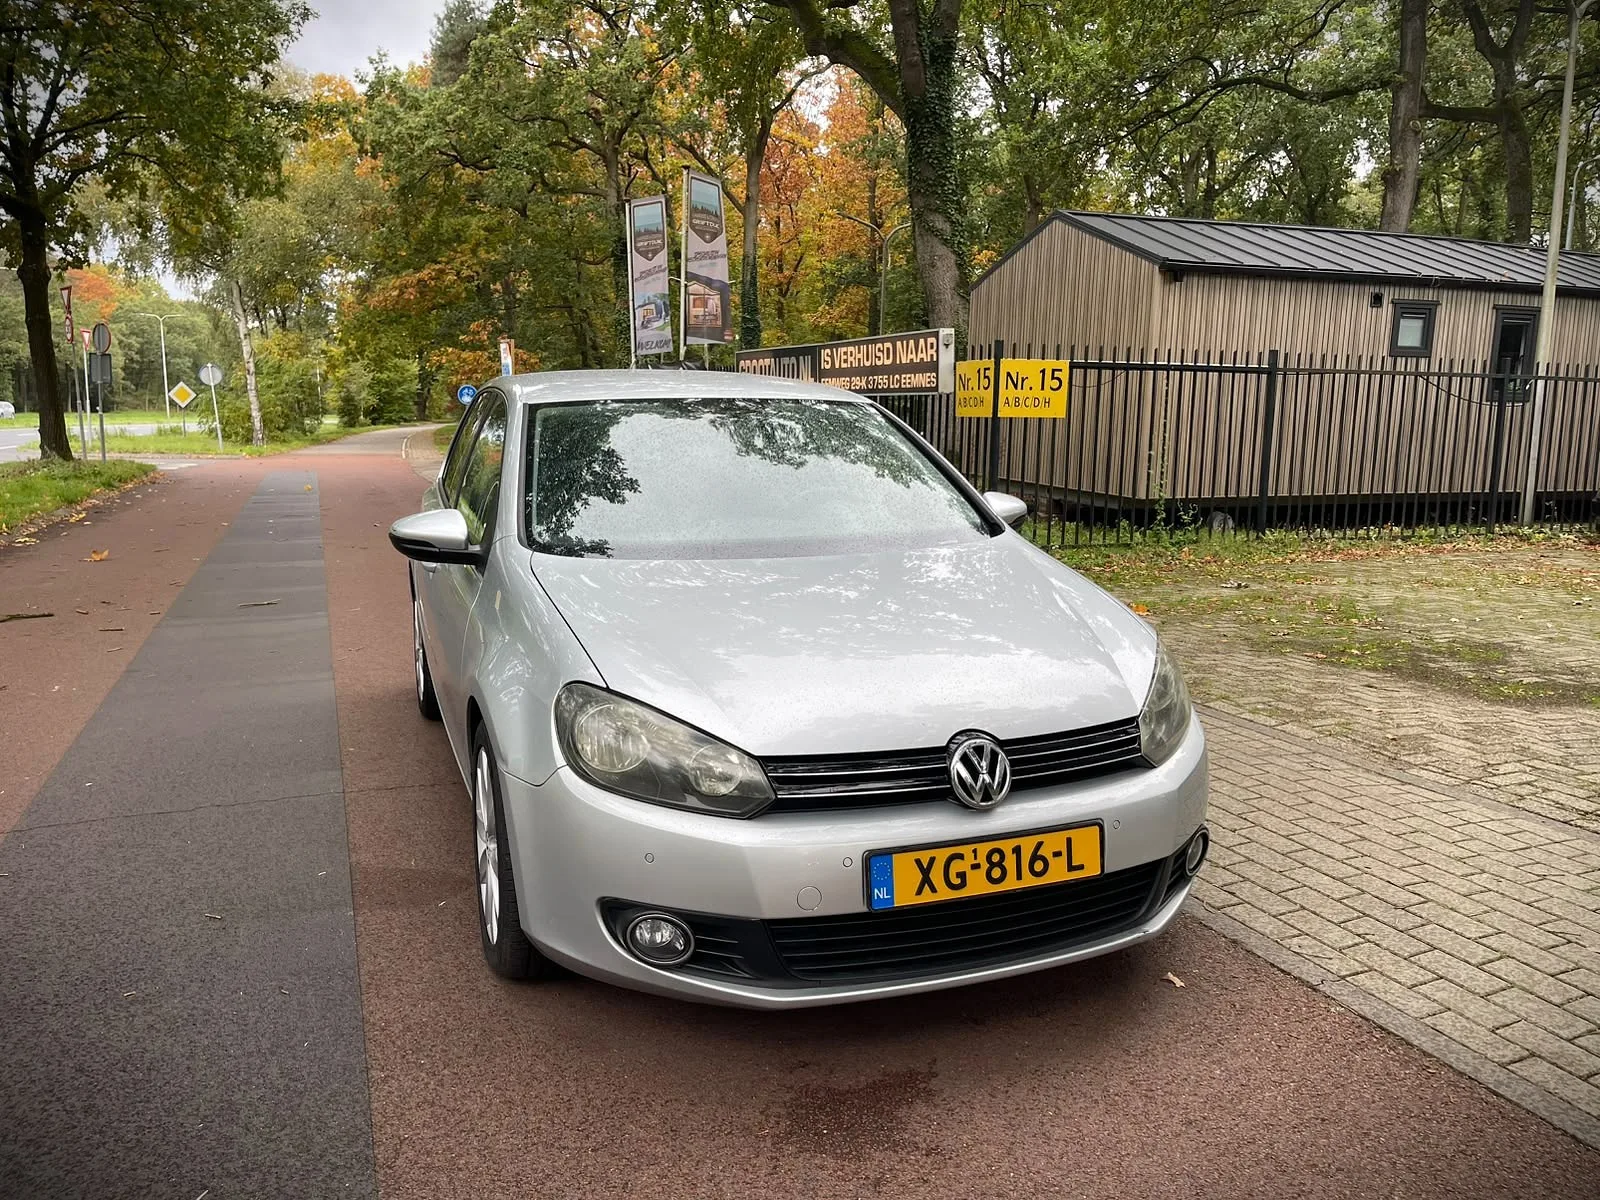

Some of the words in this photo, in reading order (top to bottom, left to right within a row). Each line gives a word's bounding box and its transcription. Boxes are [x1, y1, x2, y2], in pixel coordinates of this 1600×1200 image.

[821, 349, 831, 369] IS
[833, 342, 893, 369] VERHUISD
[896, 337, 937, 364] NAAR
[868, 374, 888, 389] 3755
[890, 374, 900, 389] LC
[901, 372, 937, 388] EEMNES
[959, 373, 974, 391] Nr.
[977, 367, 991, 391] 15
[1005, 371, 1033, 391] Nr.
[1039, 367, 1063, 392] 15
[1003, 396, 1051, 408] A/B/C/D/H
[874, 887, 891, 900] NL
